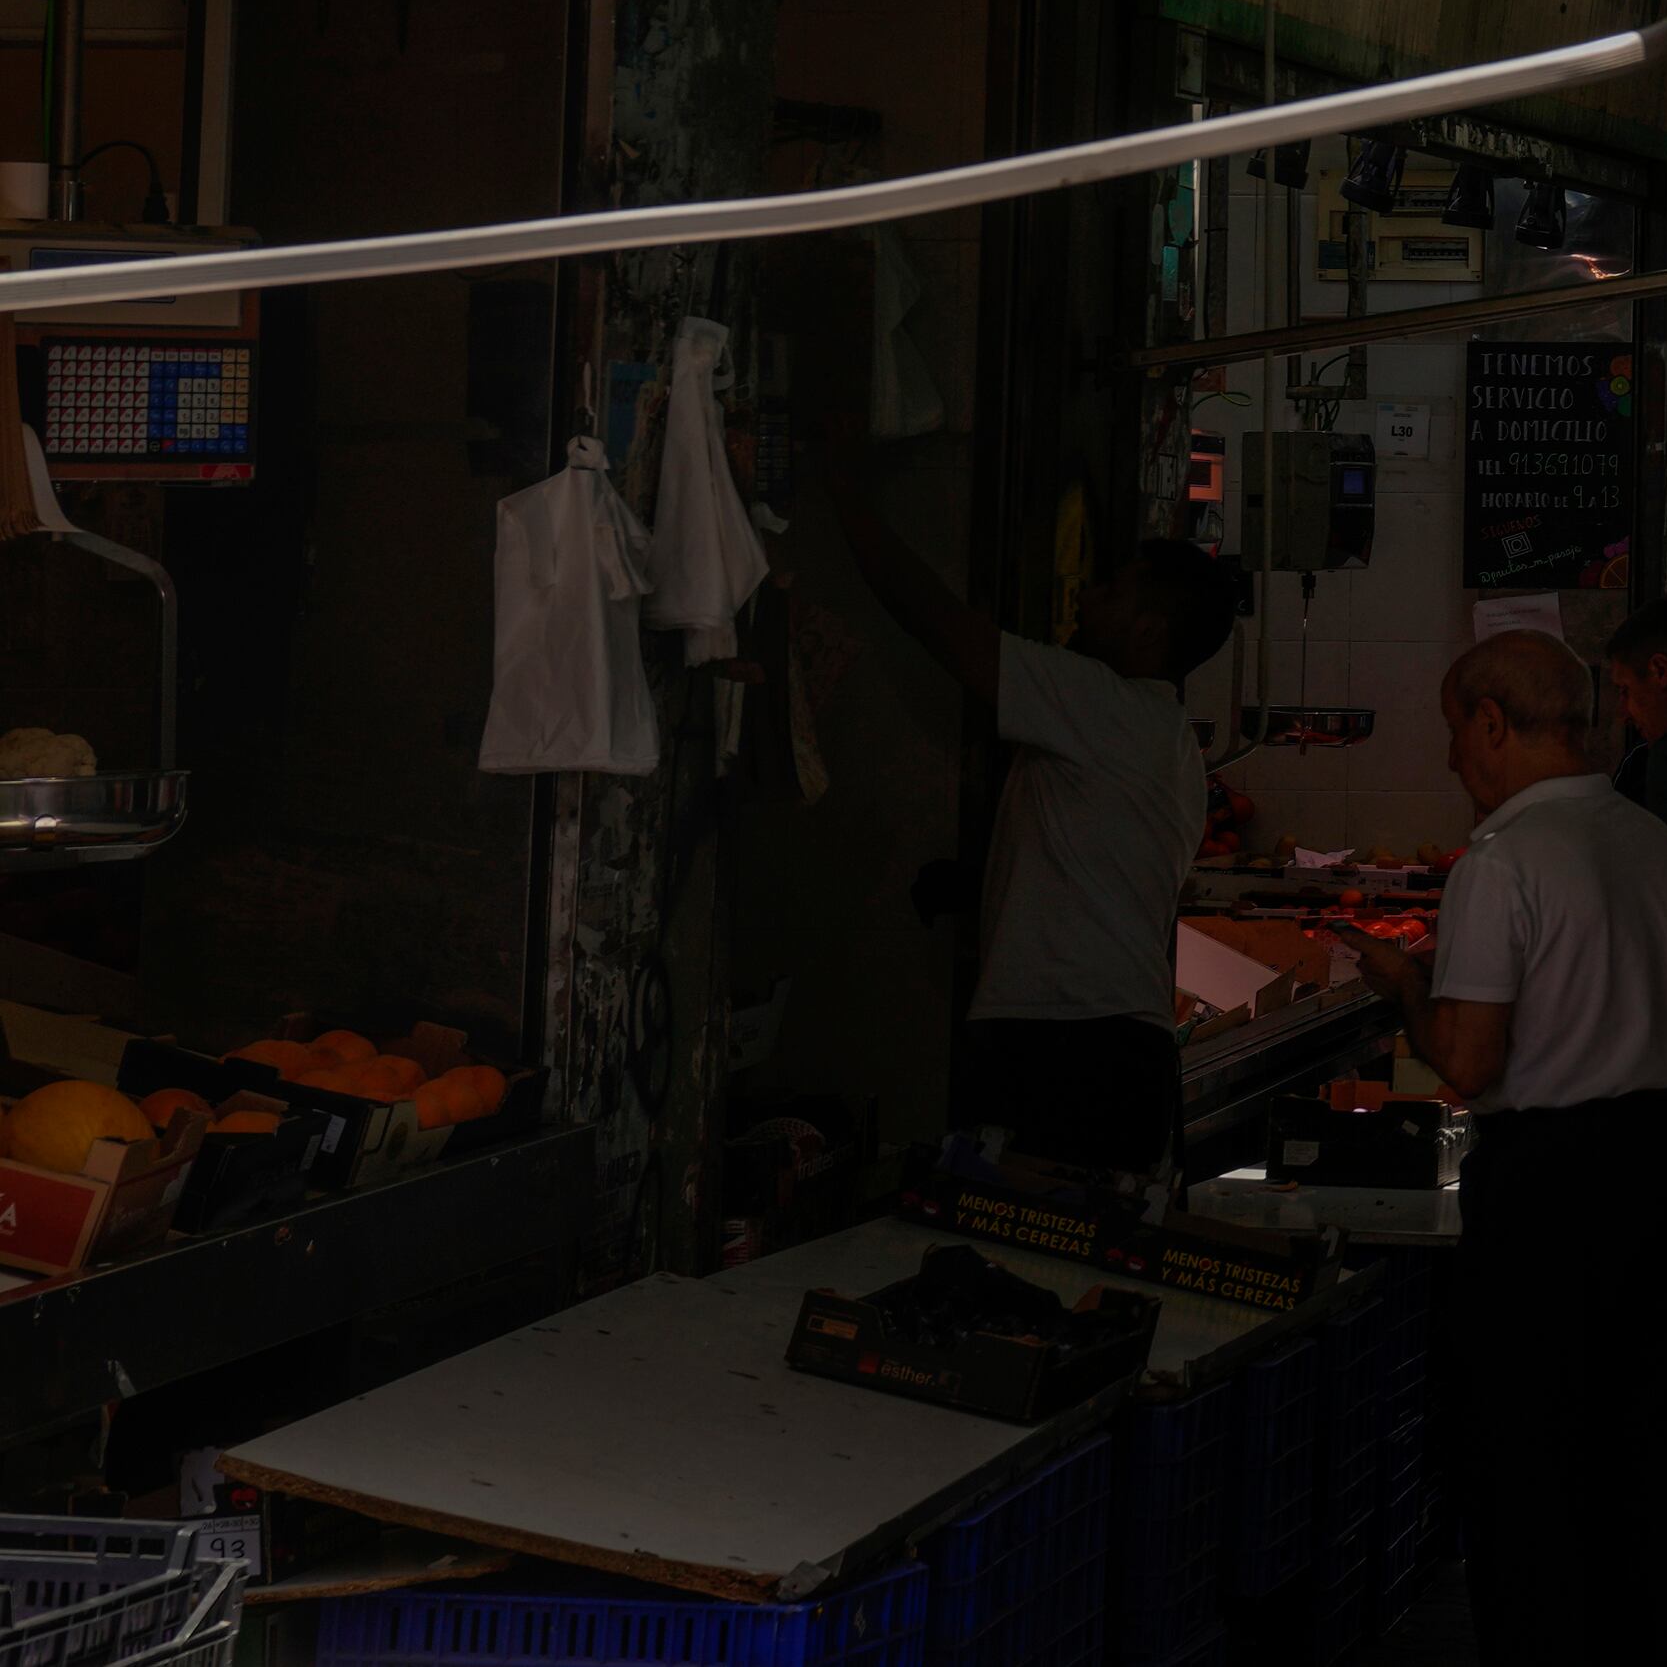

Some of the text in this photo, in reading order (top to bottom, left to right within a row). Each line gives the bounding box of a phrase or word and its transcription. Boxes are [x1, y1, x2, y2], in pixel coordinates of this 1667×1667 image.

[1481, 352, 1596, 377] TENEMOS
[1471, 385, 1576, 410] SERVICIO
[1391, 425, 1413, 438] L30
[1470, 419, 1609, 443] A DOMICILIO
[1508, 451, 1620, 477] 913691079
[1480, 492, 1551, 509] HORARIO
[1554, 495, 1569, 509] DE
[1573, 484, 1585, 509] 9
[1600, 485, 1622, 509] 13
[958, 1192, 1097, 1238] MENOS TRISTEZAS
[955, 1211, 967, 1226] Y
[1015, 1226, 1092, 1257] CEREZAS
[1162, 1248, 1302, 1294] MENOS TRISTEZAS
[1160, 1266, 1170, 1281] Y
[1220, 1281, 1296, 1311] CEREZAS
